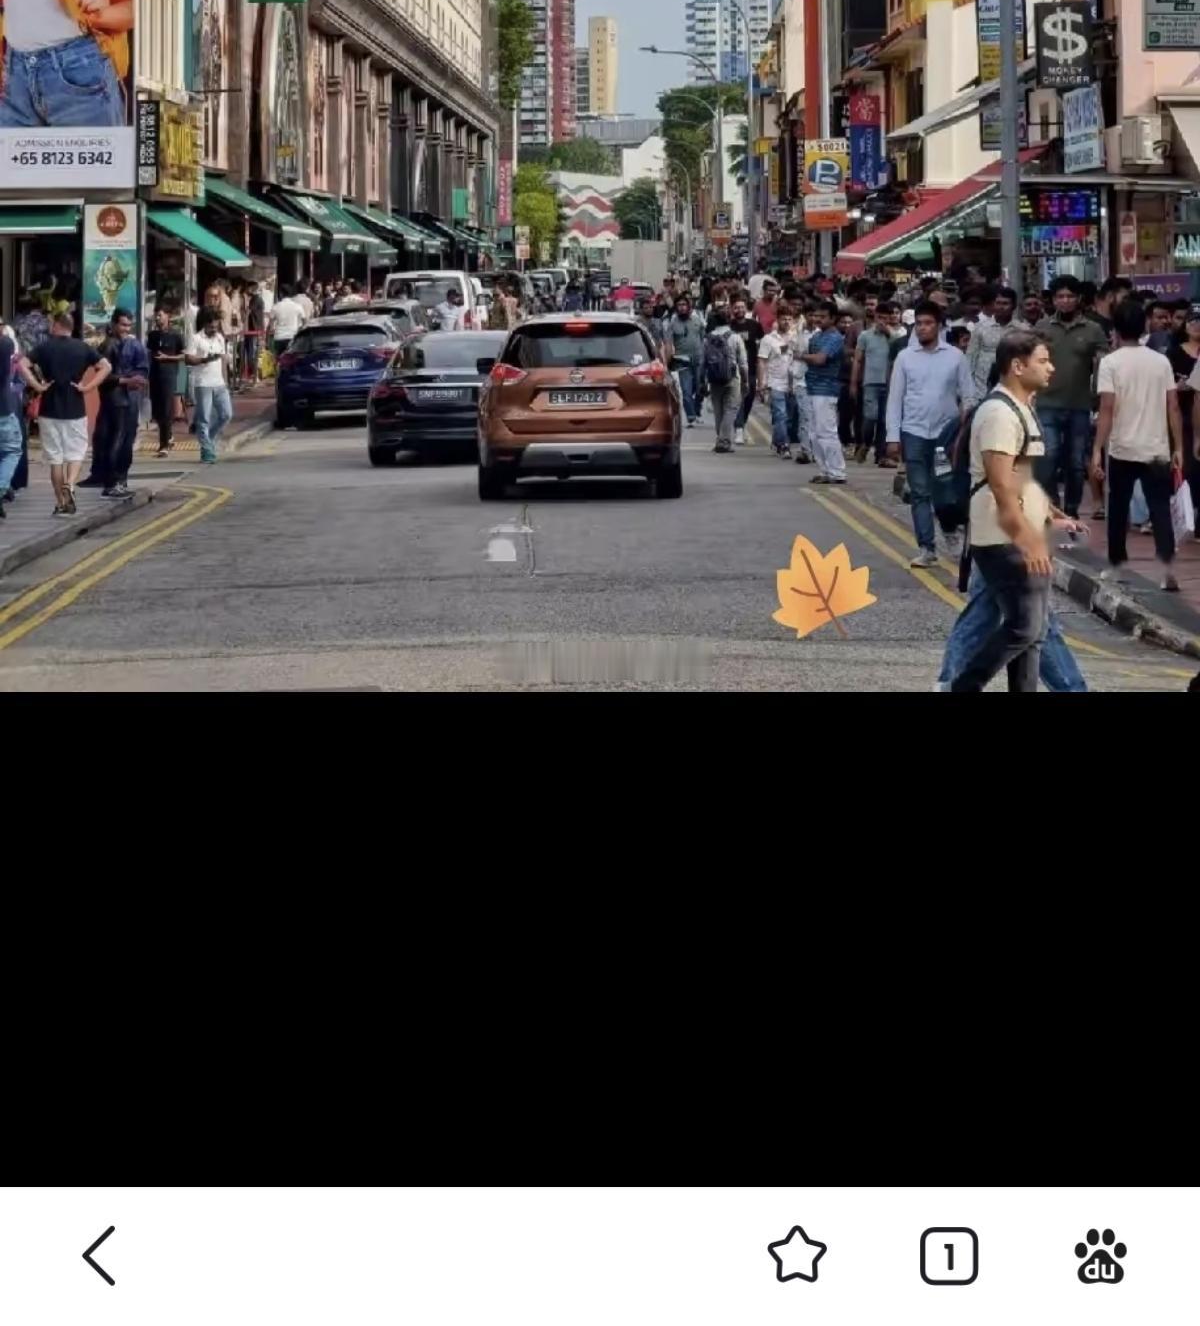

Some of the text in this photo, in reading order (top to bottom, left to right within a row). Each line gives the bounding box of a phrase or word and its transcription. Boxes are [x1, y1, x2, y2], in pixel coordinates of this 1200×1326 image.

[1048, 67, 1082, 75] MONEY
[1042, 75, 1090, 83] CHANGER
[11, 151, 113, 165] +65 8123 6342
